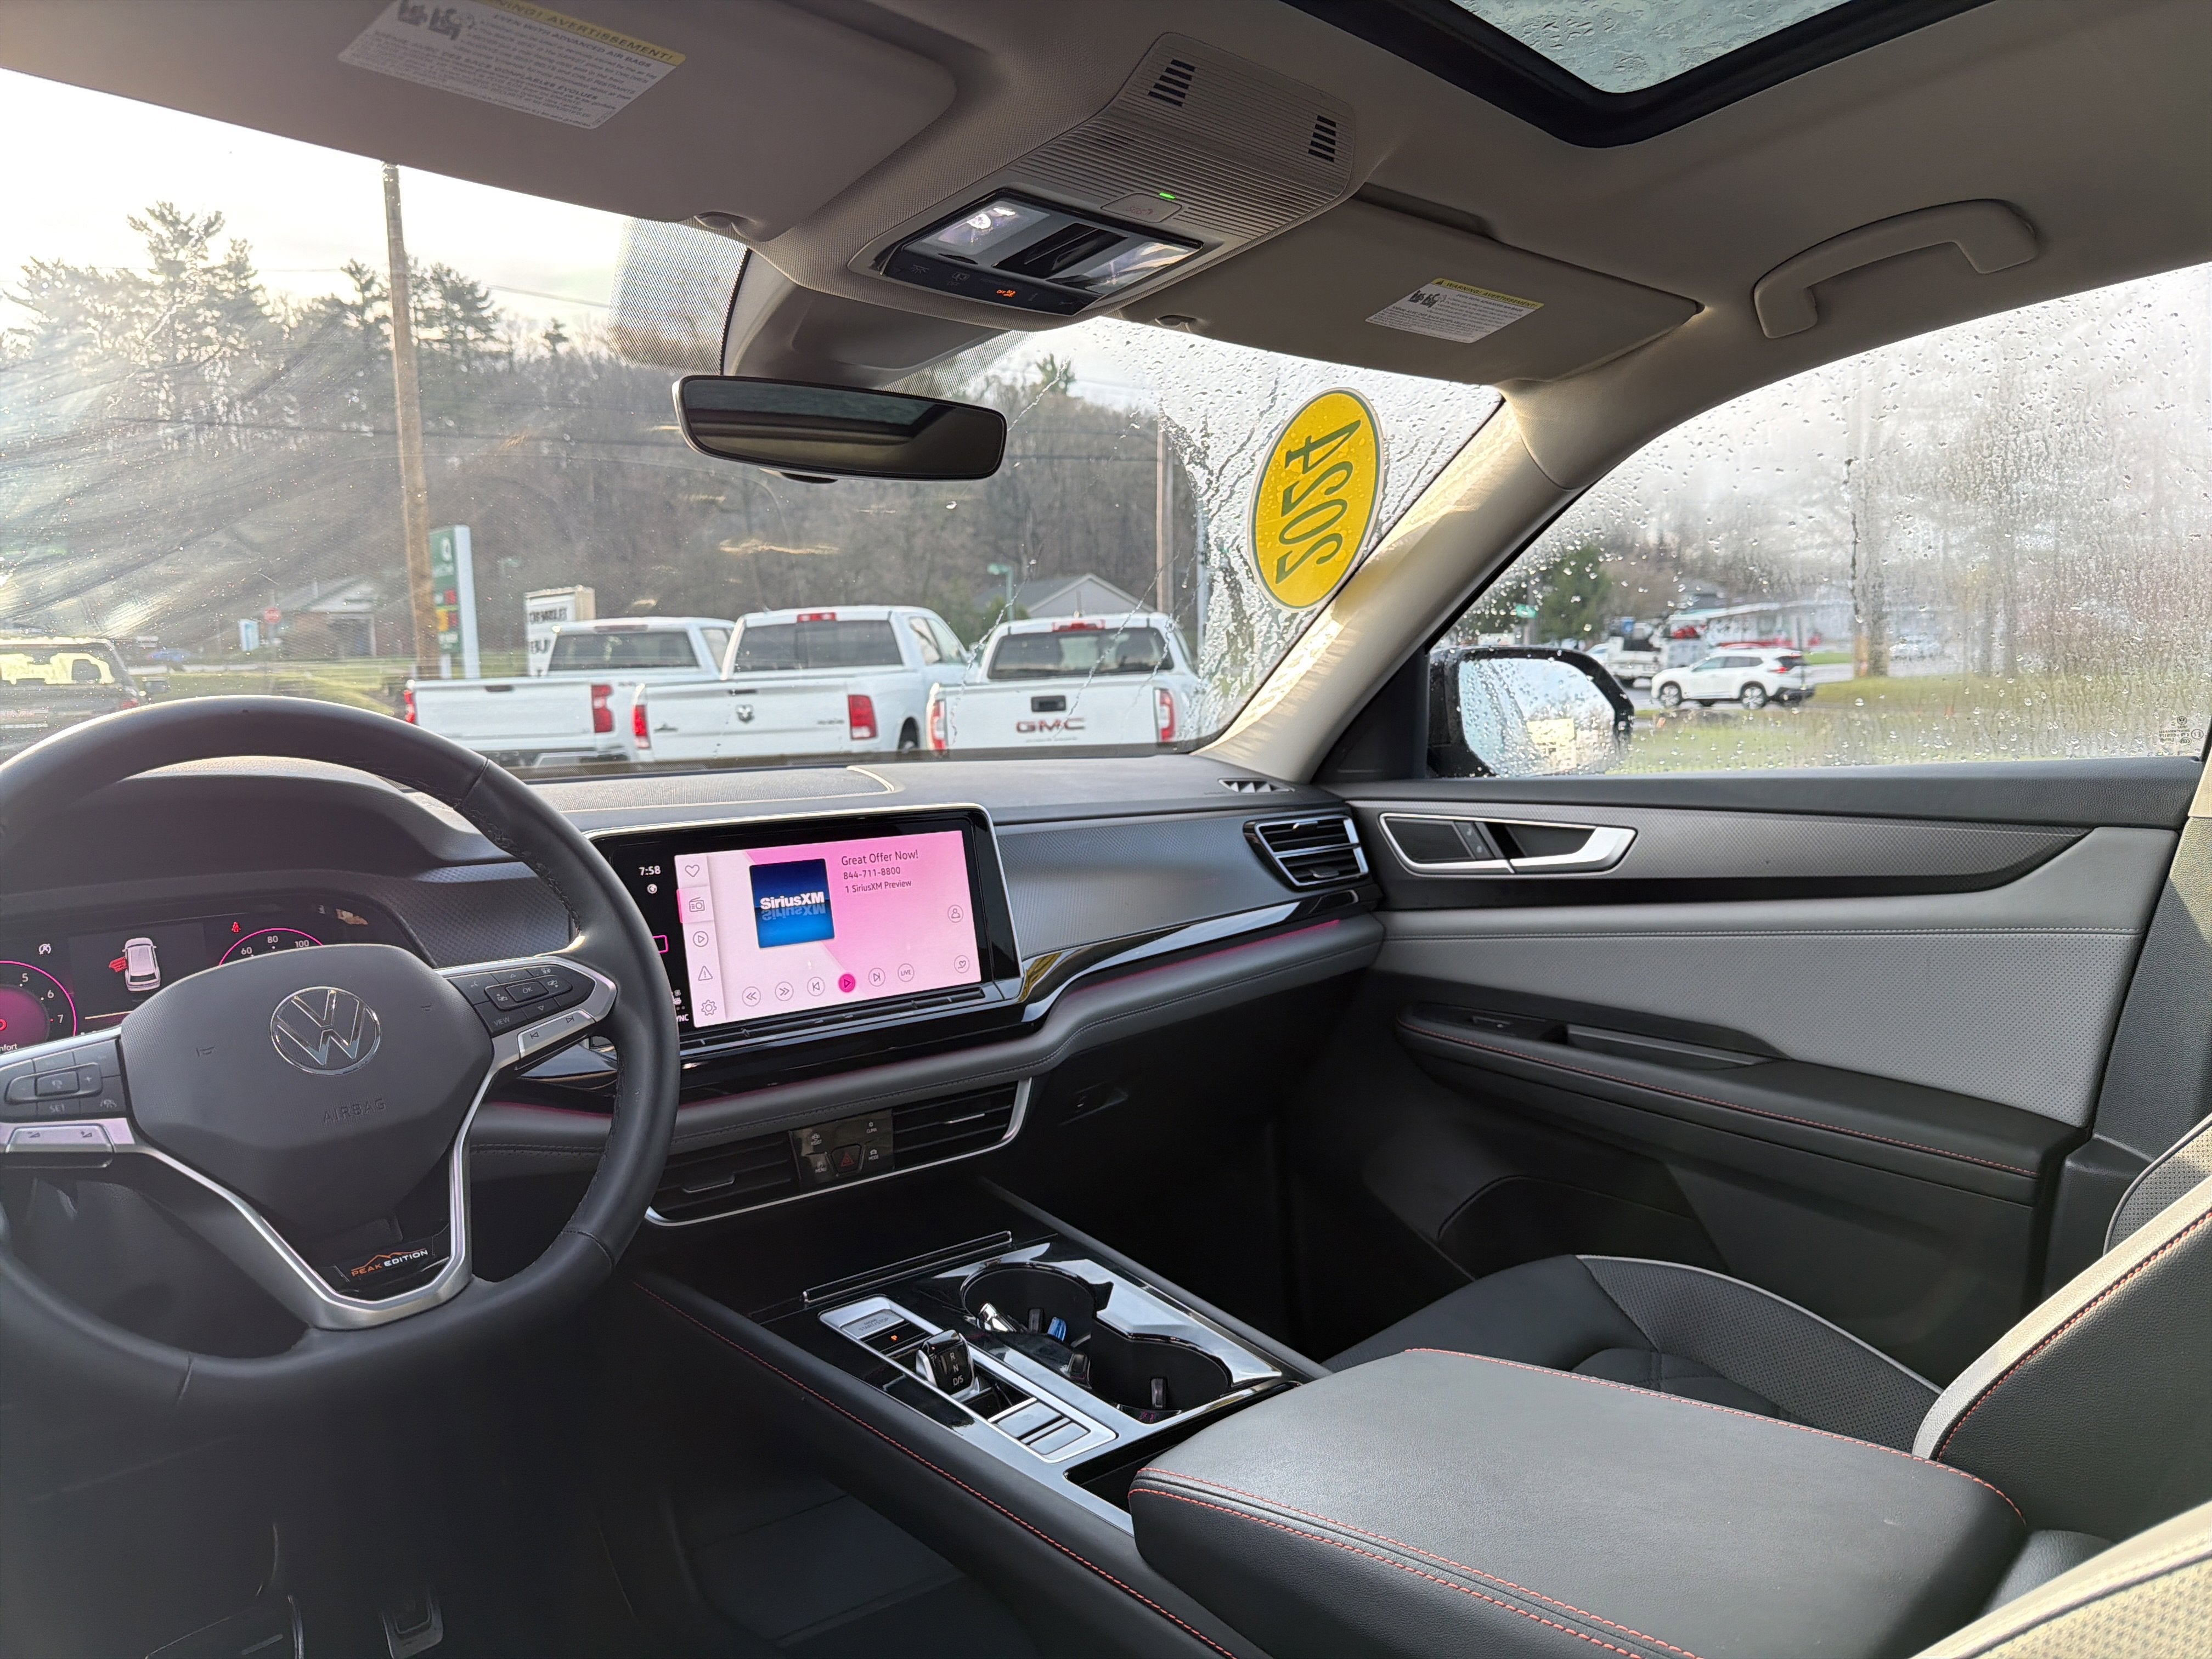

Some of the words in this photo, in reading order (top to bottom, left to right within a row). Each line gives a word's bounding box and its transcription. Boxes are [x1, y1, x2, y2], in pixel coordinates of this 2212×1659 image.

[548, 16, 673, 61] AVERTISSEMENT!
[1016, 718, 1085, 733] GMC
[842, 855, 867, 866] Great
[869, 853, 892, 863] Offer
[895, 849, 918, 861] Now!
[639, 865, 661, 876] 7:58
[843, 867, 901, 880] 844-711-8800
[851, 882, 883, 893] SiriusXM
[884, 880, 912, 889] Preview
[760, 891, 825, 910] SiriusXM
[267, 935, 279, 944] 80
[295, 940, 309, 948] 100
[241, 946, 252, 955] 60
[22, 973, 29, 982] 5
[47, 989, 54, 998] 6
[58, 1014, 64, 1024] 7
[494, 1016, 510, 1026] VIEW
[675, 1013, 690, 1022] YNC
[324, 1098, 386, 1123] AIRBAG
[351, 1263, 382, 1277] PEAK
[383, 1249, 428, 1267] EDITION
[950, 1352, 956, 1361] R
[953, 1363, 959, 1373] N
[953, 1375, 964, 1386] D/S
